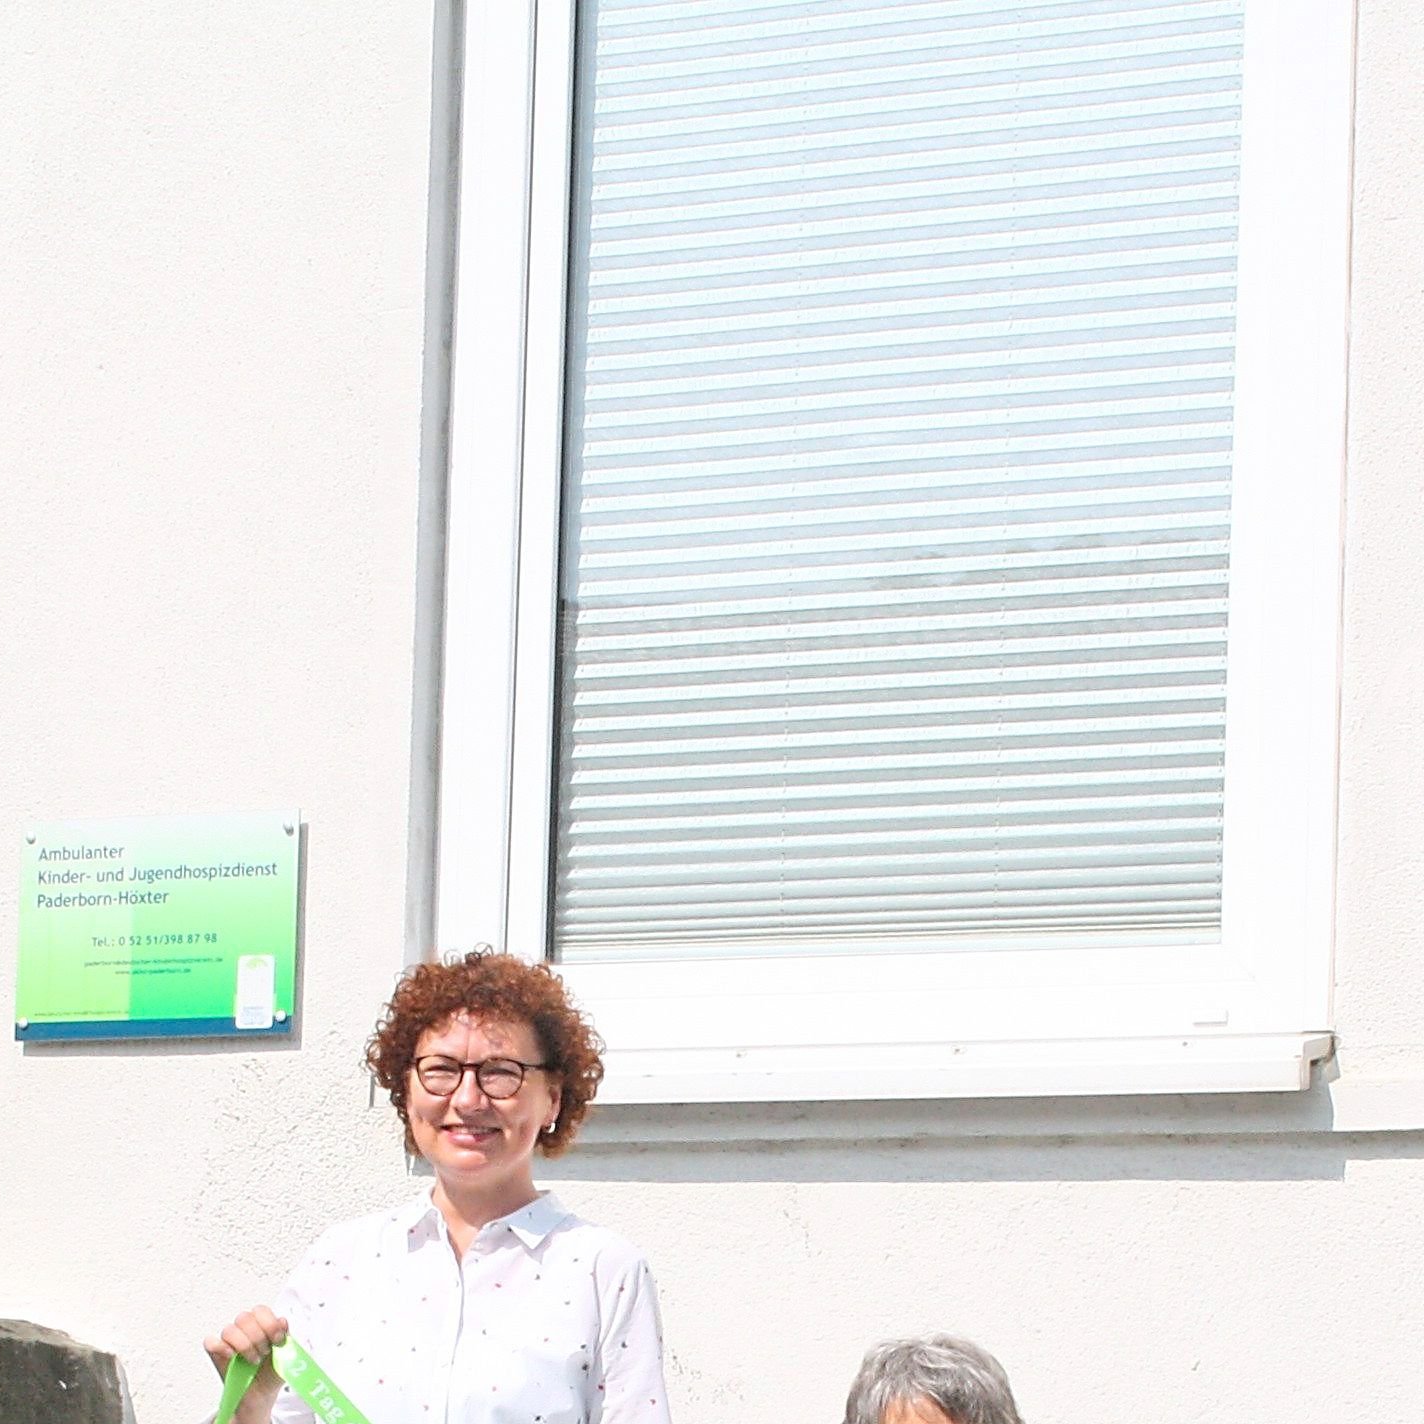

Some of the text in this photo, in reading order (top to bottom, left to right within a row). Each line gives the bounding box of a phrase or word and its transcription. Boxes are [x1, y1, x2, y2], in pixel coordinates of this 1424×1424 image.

[38, 845, 125, 862] Ambulanter
[37, 862, 279, 885] Kinder- und Jugendhospizdienst
[36, 889, 170, 909] Paderborn-Höxter
[91, 933, 218, 947] Tel.: 0 52 51/398 87 98
[309, 1379, 345, 1424] Tag
